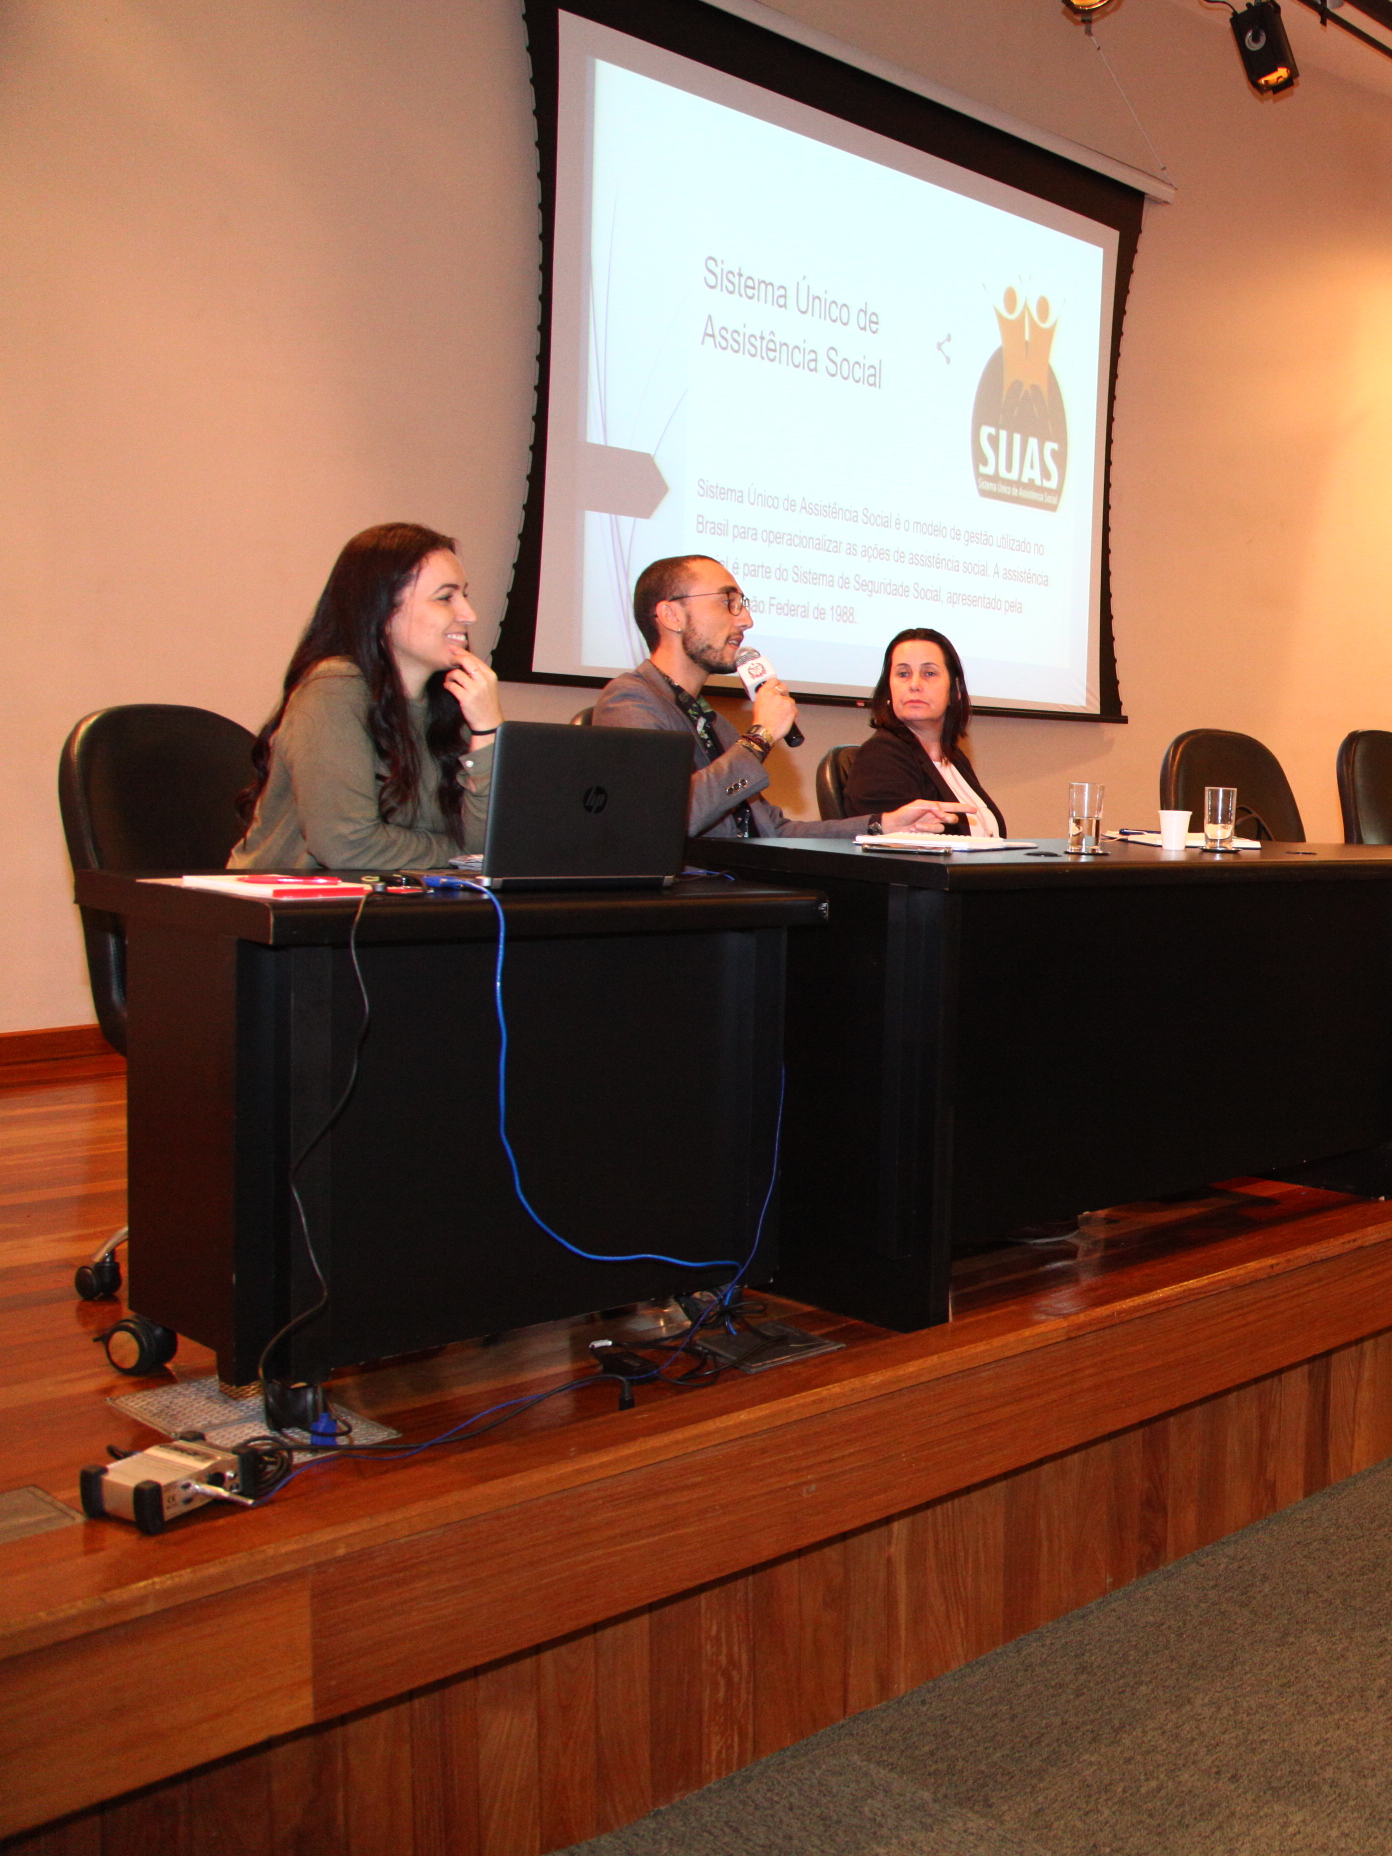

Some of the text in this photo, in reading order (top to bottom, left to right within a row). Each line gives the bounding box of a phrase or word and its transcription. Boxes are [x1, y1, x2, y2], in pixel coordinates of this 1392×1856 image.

[703, 256, 880, 334] Sistema Único de
[701, 314, 882, 389] Assistência Social
[978, 425, 1059, 490] SUAS
[696, 514, 1049, 587] Brasil para operacionalizar as ações de assistência social. A assistência
[697, 478, 1045, 556] Sistema Único de Assistência Social é o modelo de gestão utilizado no
[731, 556, 740, 576] é
[742, 561, 772, 581] parte
[774, 563, 789, 582] do
[791, 565, 834, 588] Sistema
[837, 572, 851, 590] de
[853, 574, 910, 597] Seguridade
[912, 582, 944, 606] Social,
[946, 590, 1002, 611] apresentado
[1003, 599, 1023, 615] pela
[768, 596, 810, 619] Federal
[812, 602, 826, 620] de
[829, 604, 859, 624] 1988.
